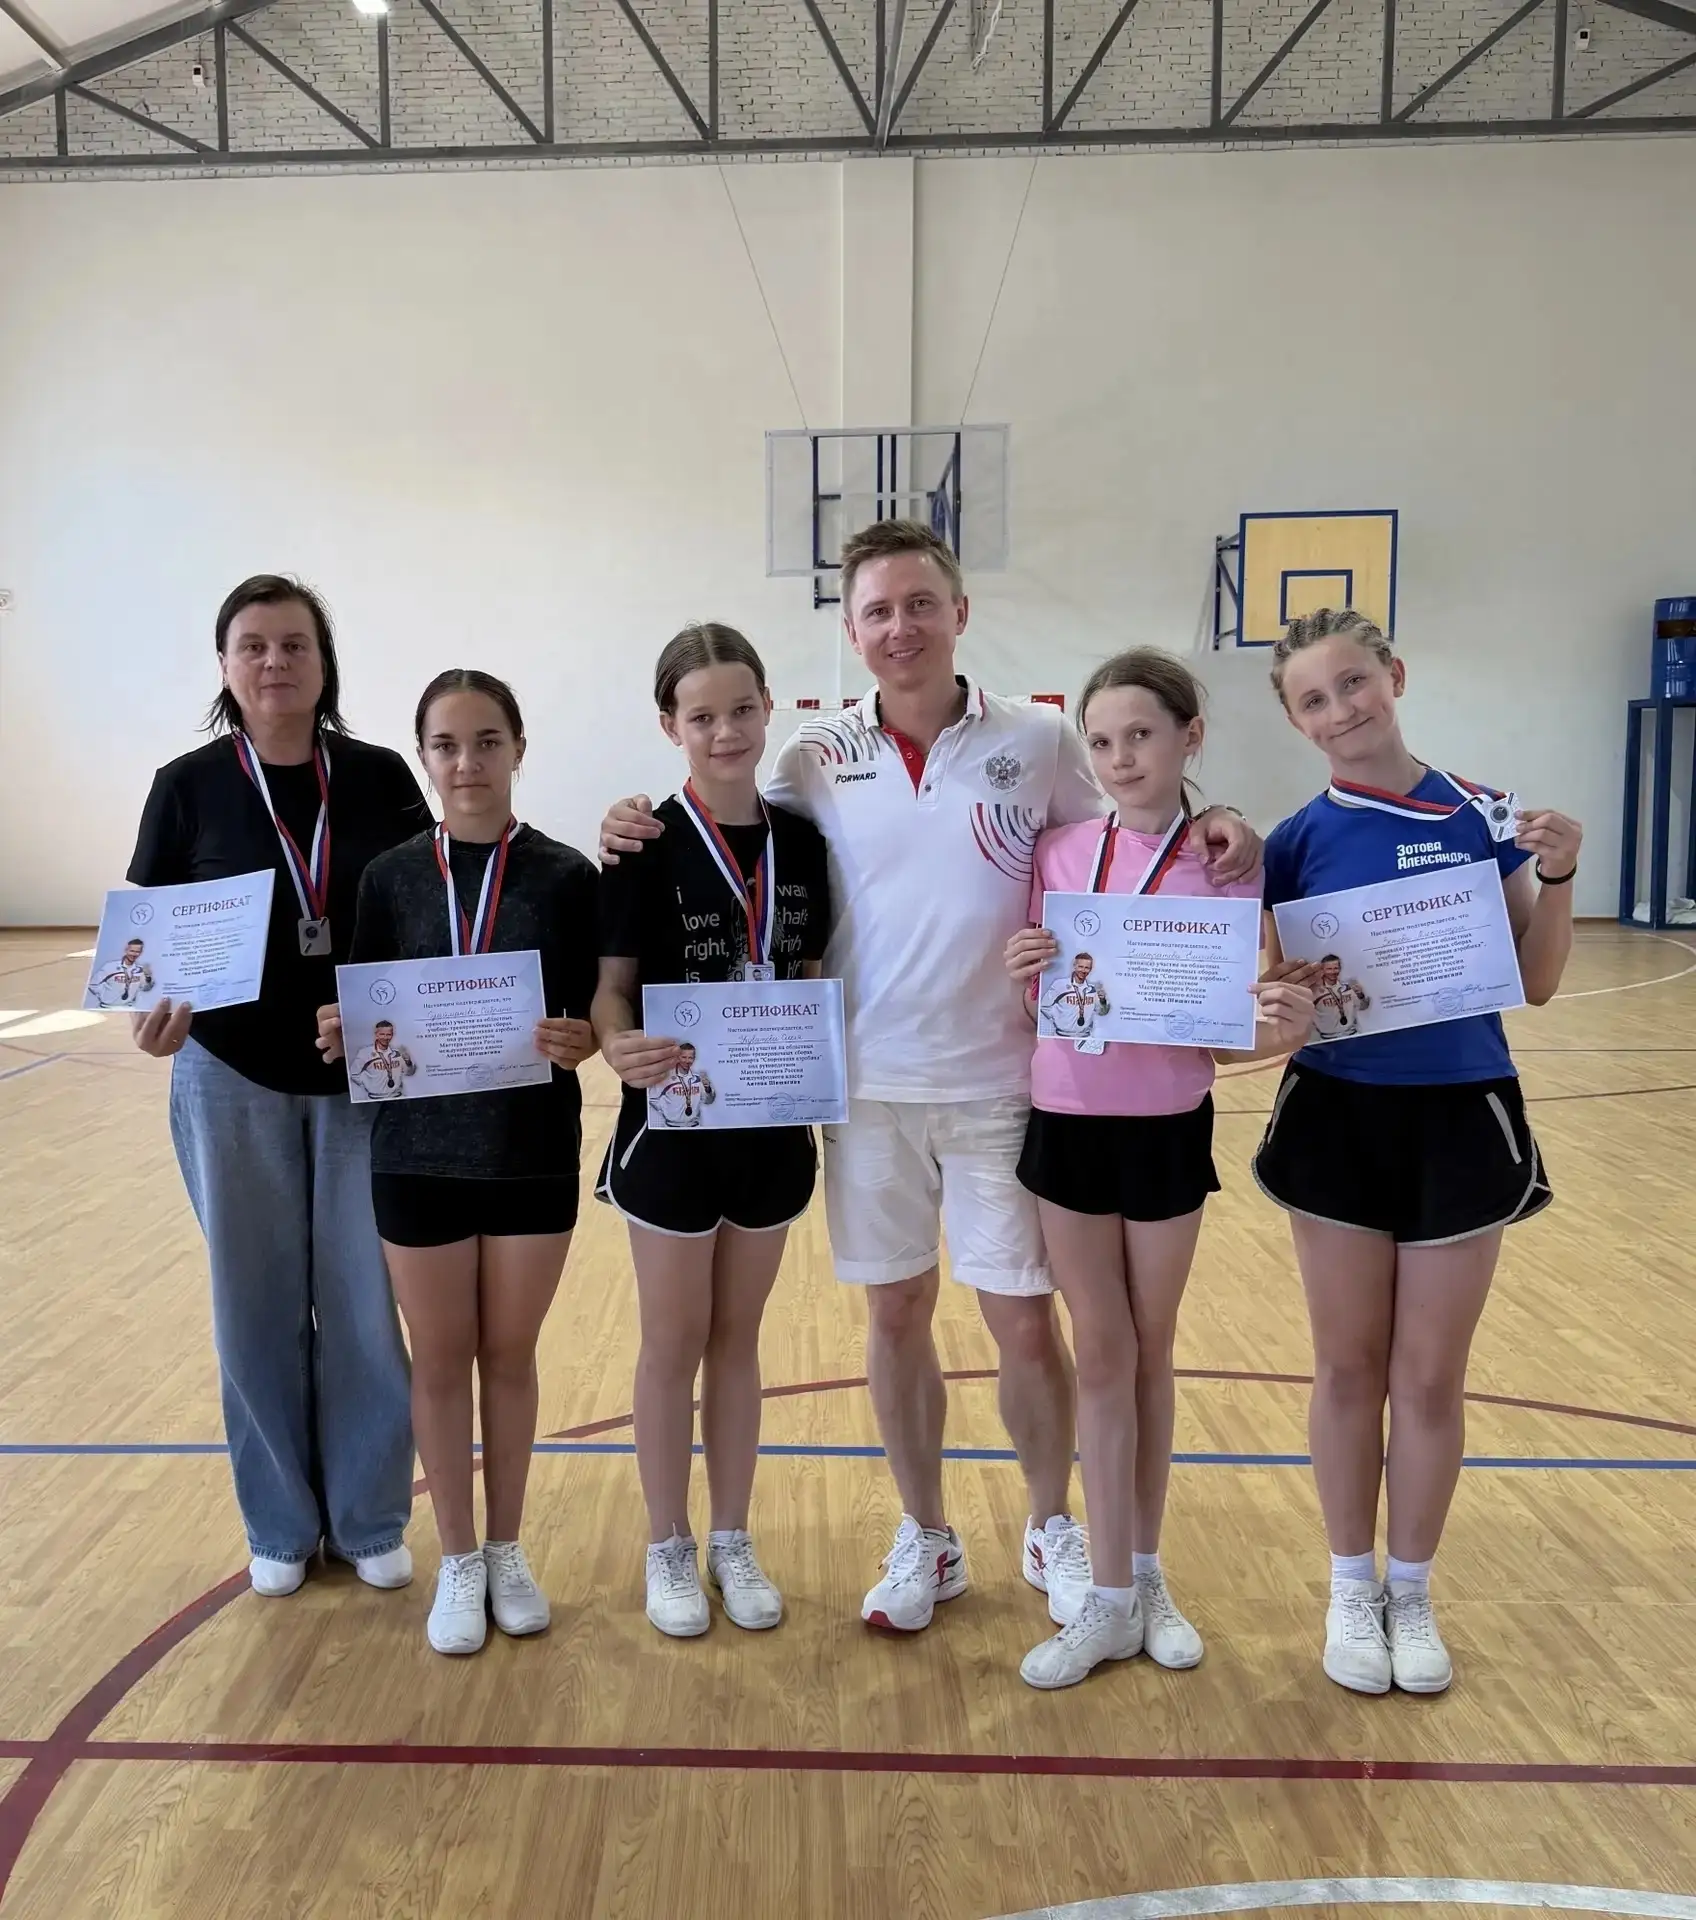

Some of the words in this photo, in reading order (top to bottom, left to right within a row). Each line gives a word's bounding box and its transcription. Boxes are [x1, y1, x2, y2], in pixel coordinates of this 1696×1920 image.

[835, 771, 877, 784] FORWARD
[1396, 841, 1442, 857] Зотова
[1397, 852, 1472, 870] Александра
[676, 886, 683, 904] i
[172, 895, 252, 917] СЕРТИФИКАТ
[1362, 889, 1473, 923] СЕРТИФИКАТ
[682, 912, 720, 931] love
[1123, 919, 1231, 935] СЕРТИФИКАТ
[684, 937, 730, 961] right,
[685, 967, 700, 983] is
[417, 975, 517, 994] СЕРТИФИКАТ
[722, 1003, 820, 1019] СЕРТИФИКАТ
